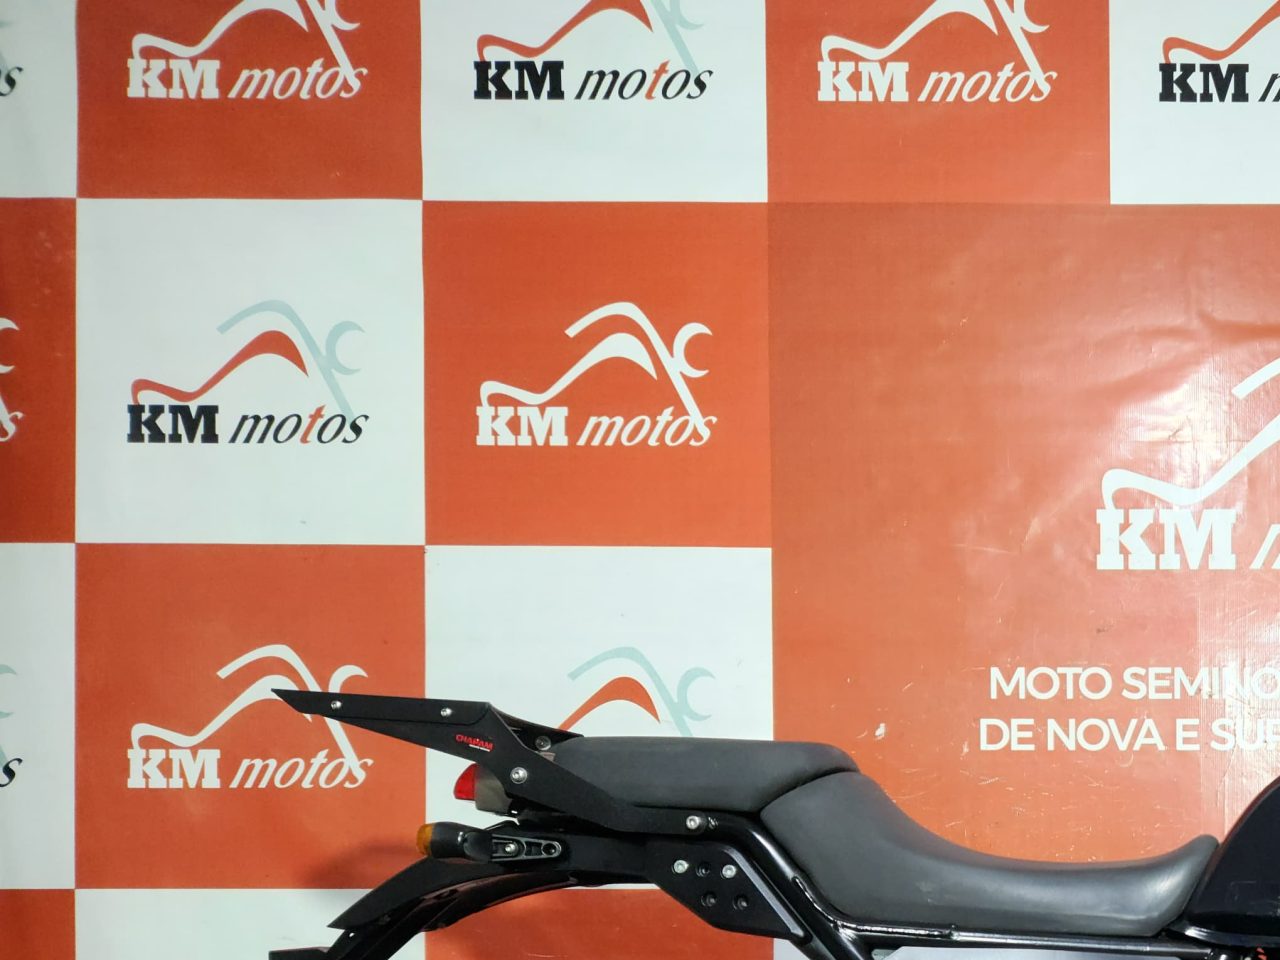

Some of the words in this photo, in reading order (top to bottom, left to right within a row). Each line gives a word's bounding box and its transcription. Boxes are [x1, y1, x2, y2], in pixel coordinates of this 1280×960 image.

[127, 58, 219, 99] KM
[227, 59, 368, 99] motos
[474, 60, 564, 100] KM
[574, 61, 713, 100] motos
[817, 61, 909, 102] KM
[917, 62, 1057, 103] motos
[1159, 63, 1249, 102] KM
[127, 404, 219, 444] KM
[228, 403, 369, 444] motos
[476, 405, 568, 446] KM
[576, 407, 717, 447] motos
[1096, 508, 1237, 570] KM
[990, 666, 1111, 699] MOTO
[979, 718, 1035, 751] DE
[1046, 718, 1166, 751] NOVA
[1176, 718, 1200, 751] E
[127, 748, 220, 789] KM
[229, 747, 374, 789] motos
